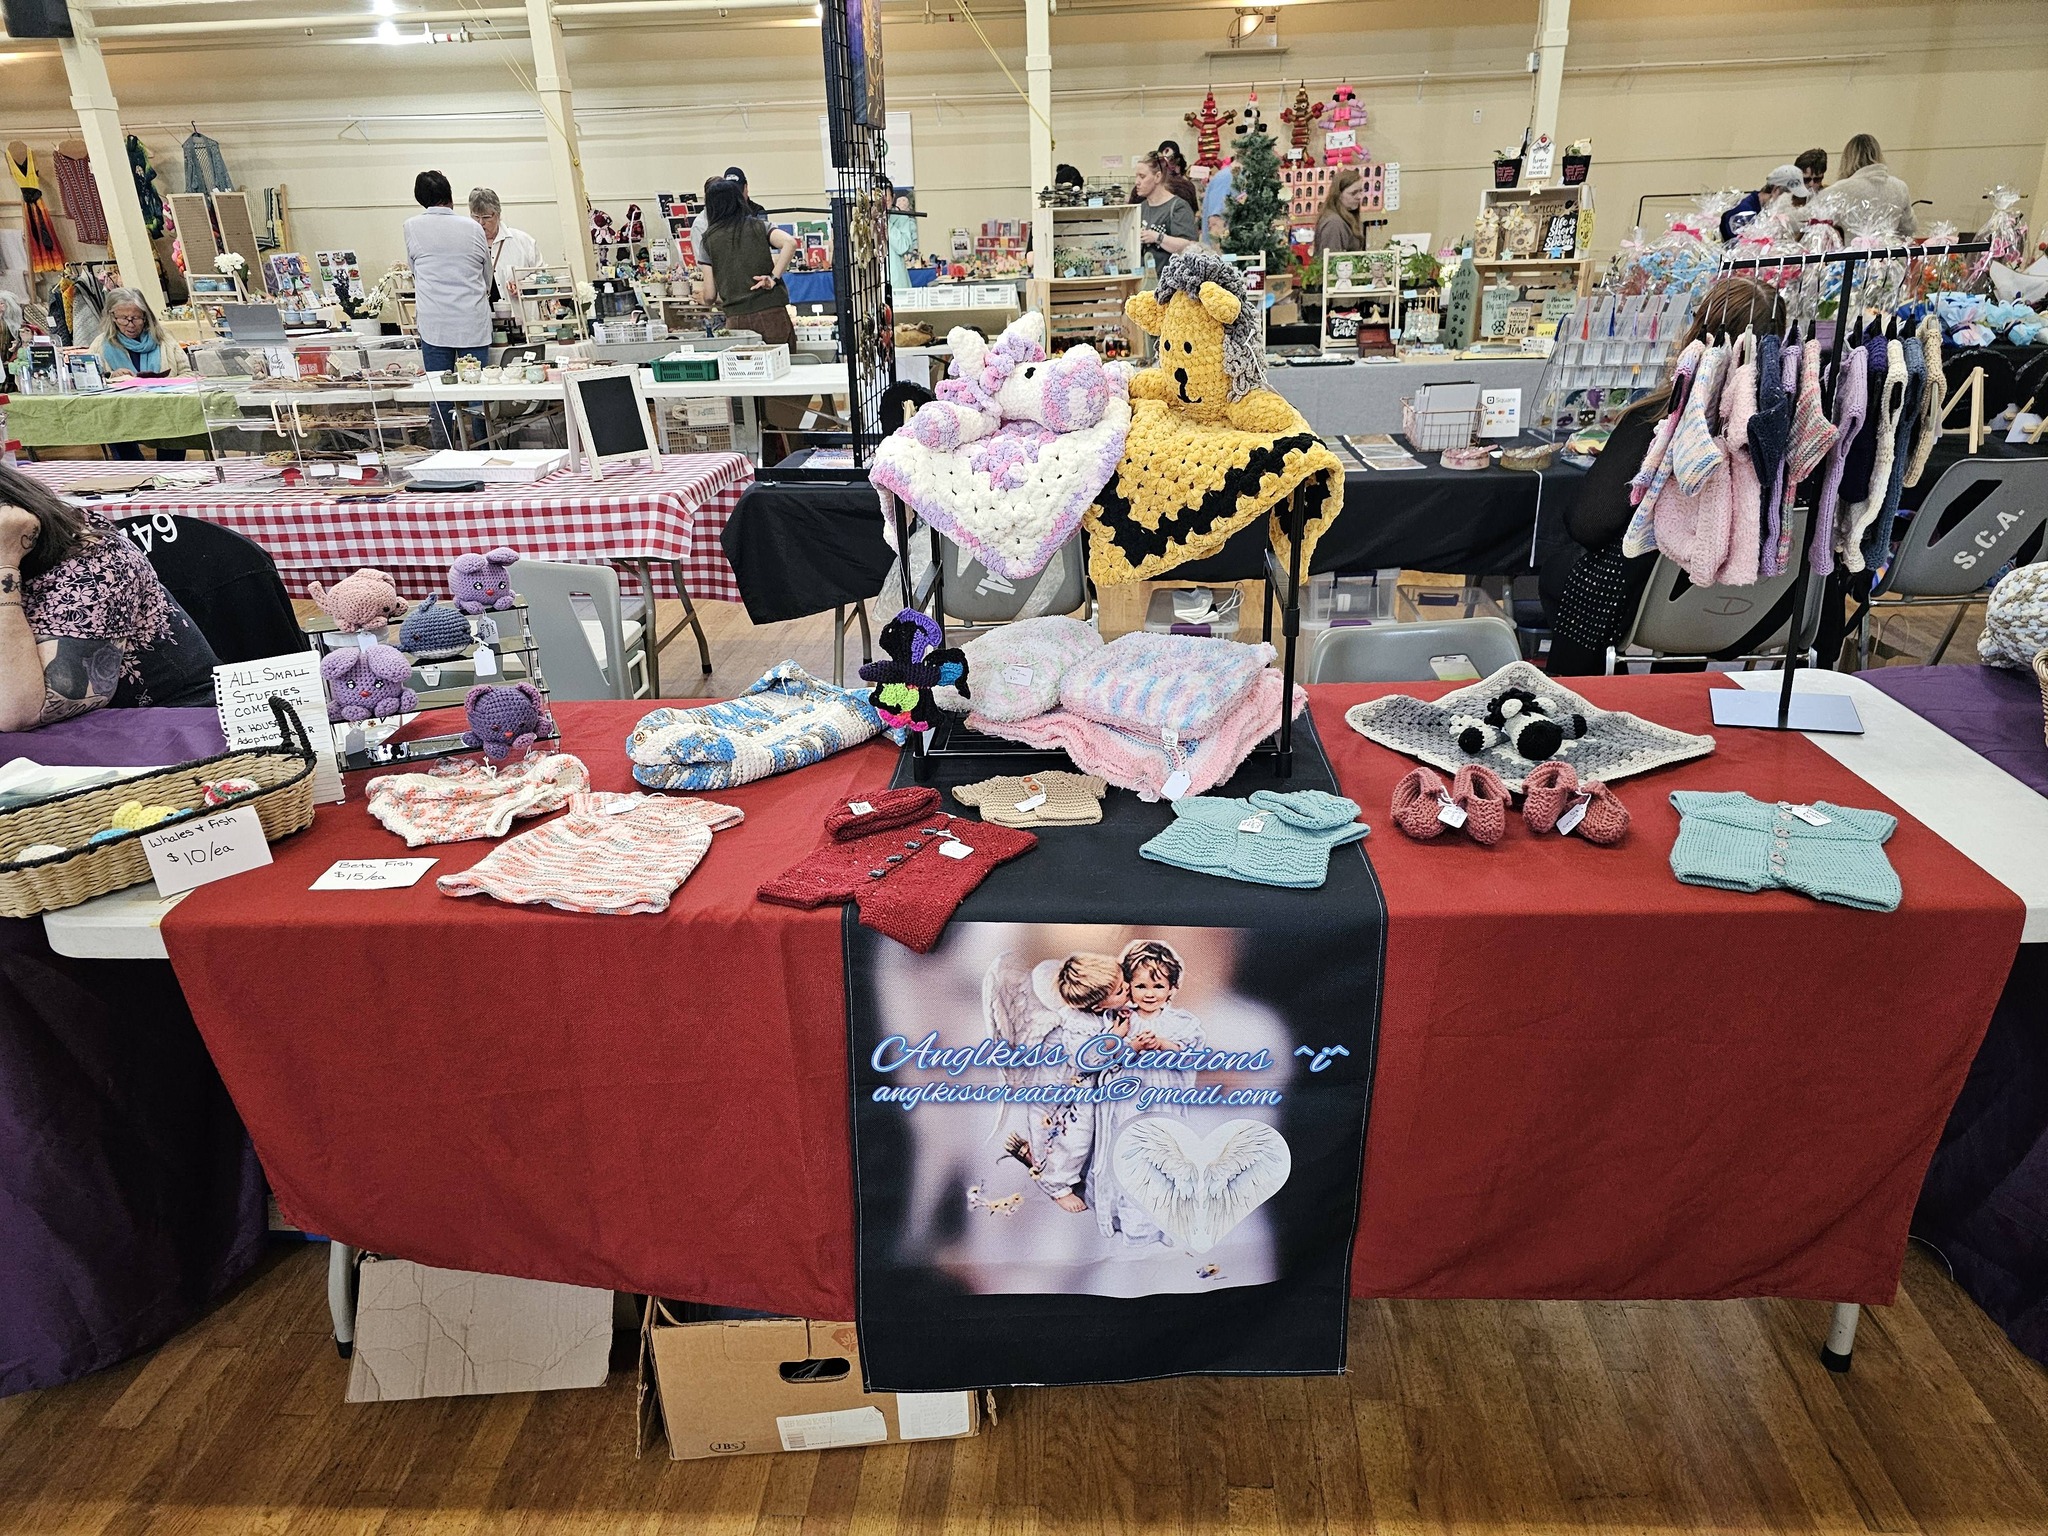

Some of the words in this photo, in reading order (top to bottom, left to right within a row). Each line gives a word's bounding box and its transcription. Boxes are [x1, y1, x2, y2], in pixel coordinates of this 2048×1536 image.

[1953, 509, 2025, 570] S.C.A.
[229, 671, 259, 688] ALL
[232, 686, 300, 704] STUFFIES
[234, 703, 269, 718] COME
[236, 725, 246, 734] A
[248, 719, 280, 732] HOUS
[148, 829, 195, 849] Whales
[207, 815, 237, 829] Fish
[384, 860, 414, 868] Fish
[871, 1030, 1070, 1077] Anglkiss
[1075, 1033, 1273, 1073] Creations
[871, 1076, 1284, 1113] anglkisscreations@gmail.com
[715, 1442, 739, 1450] JBS
